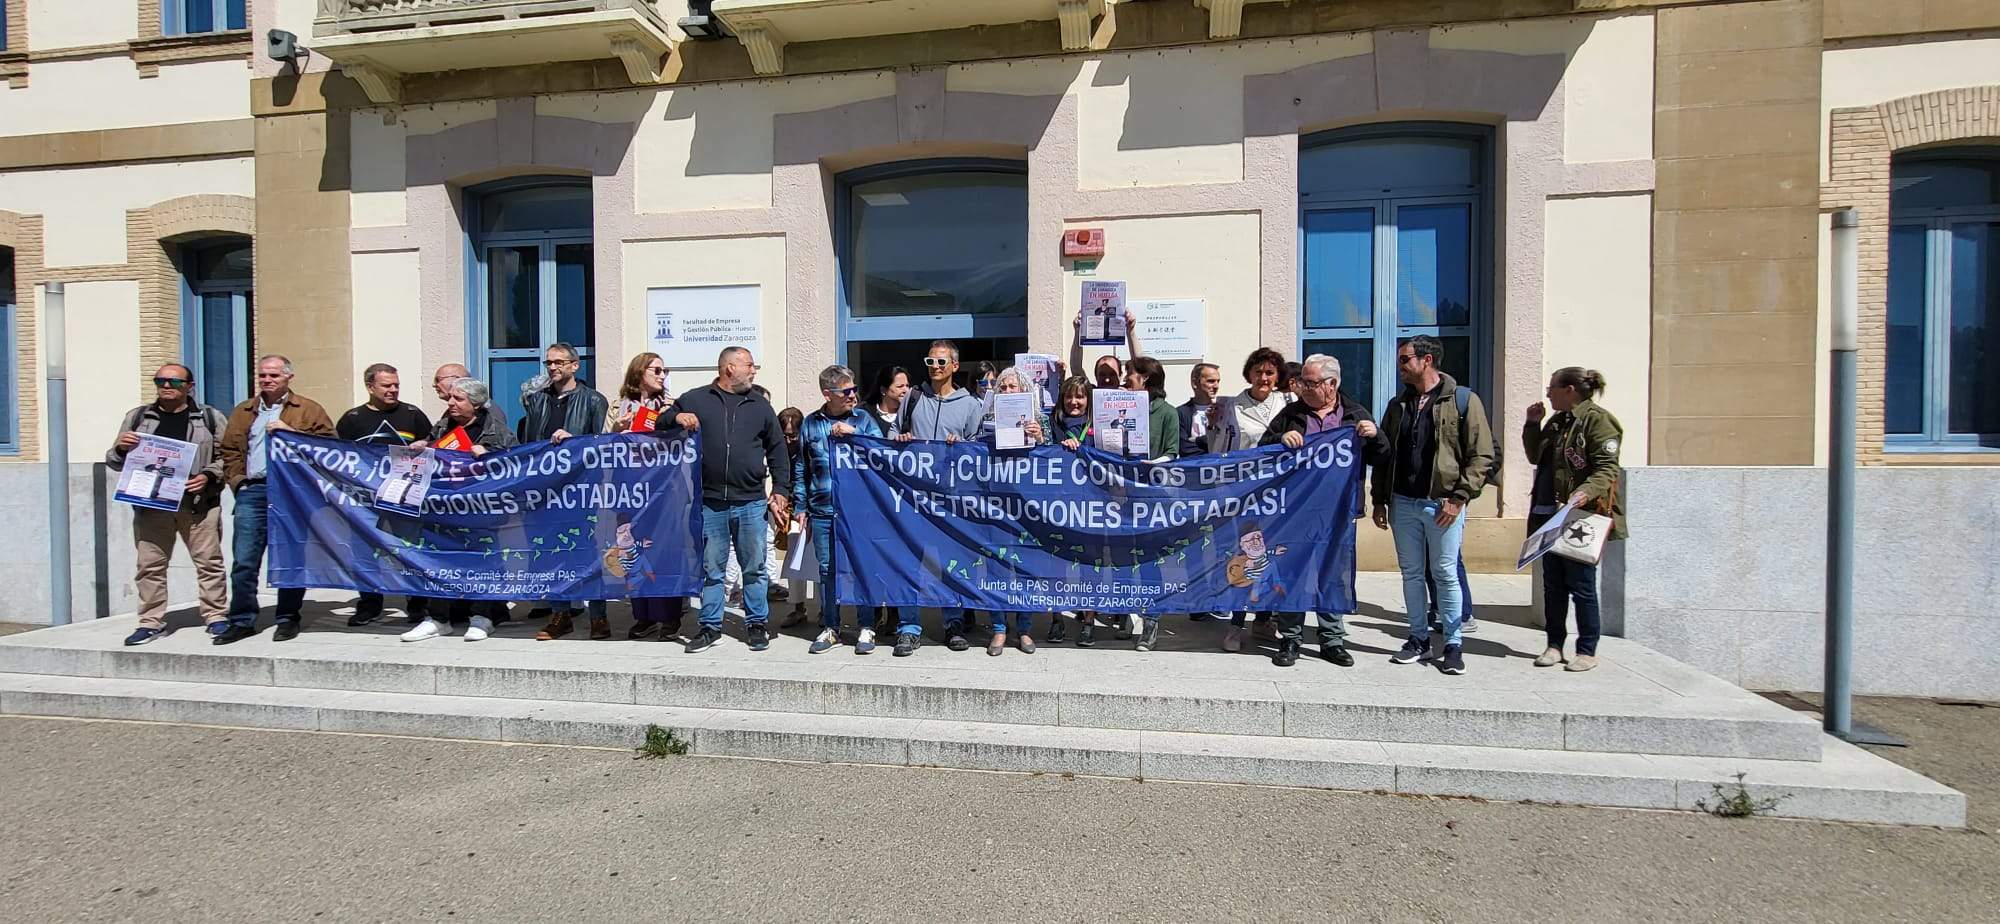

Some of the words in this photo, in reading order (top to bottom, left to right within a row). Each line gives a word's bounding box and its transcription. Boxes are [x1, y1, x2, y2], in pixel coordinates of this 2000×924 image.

[716, 317, 741, 325] Empresa
[724, 334, 757, 343] Zaragoza
[270, 436, 361, 477] RECTOR,
[469, 455, 521, 481] CON
[526, 448, 571, 477] LOS
[582, 437, 698, 470] DERECHOS
[836, 443, 941, 483] RECTOR,
[949, 453, 1063, 488] ¡CUMPLE
[1071, 457, 1126, 488] CON
[1134, 466, 1186, 488] LOS
[1200, 438, 1353, 485] DERECHOS
[525, 481, 650, 512] PACTADAS!
[889, 486, 905, 513] Y
[914, 490, 1121, 529] RETRIBUCIONES
[1132, 487, 1286, 529] PACTADAS!
[438, 568, 461, 580] PAS
[466, 569, 500, 581] Comité
[503, 569, 516, 581] de
[517, 570, 555, 584] Empresa
[558, 570, 576, 581] PAS
[424, 581, 486, 594] UNIVERSIDAD
[488, 583, 501, 594] DE
[502, 583, 551, 595] ZARAGOZA
[978, 578, 1007, 591] Junta
[1009, 578, 1023, 590] de
[1026, 579, 1049, 592] PAS
[1055, 580, 1093, 593] Comité
[1096, 581, 1110, 593] de
[1113, 582, 1161, 596] Empresa
[1164, 583, 1187, 594] PAS
[1007, 594, 1078, 607] UNIVERSIDAD
[1080, 596, 1095, 607] DE
[1097, 597, 1156, 608] ZARAGOZA
